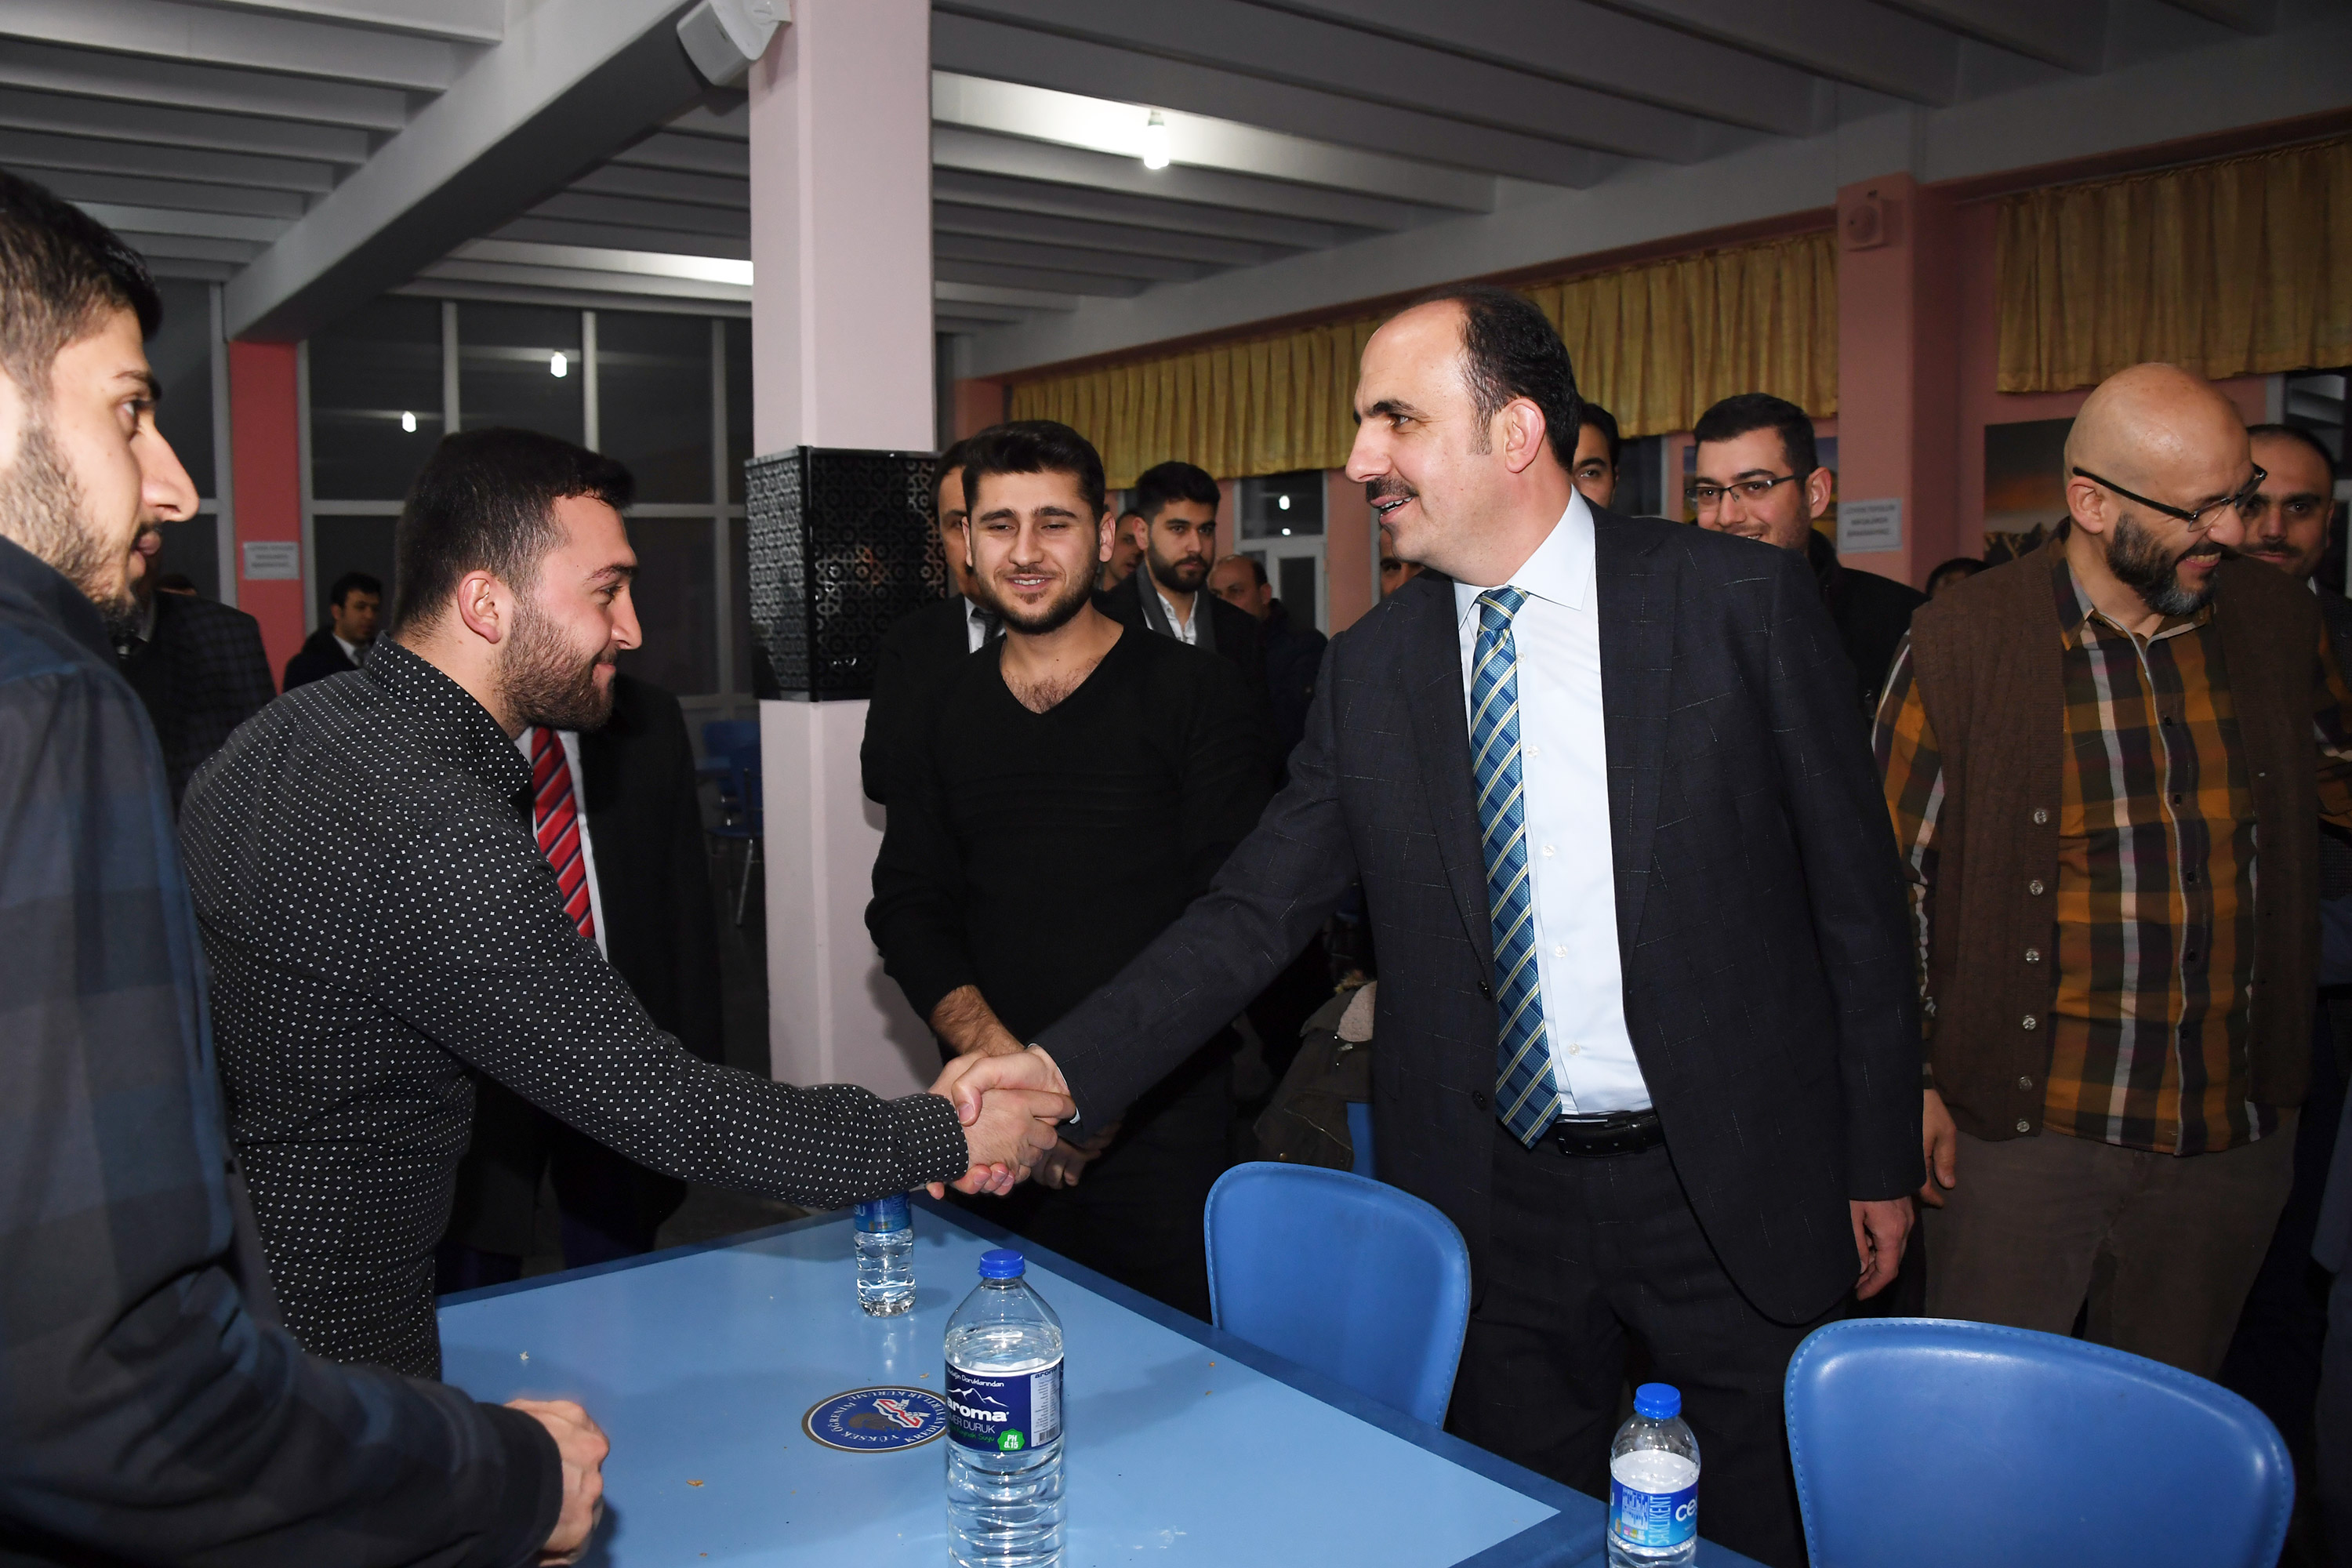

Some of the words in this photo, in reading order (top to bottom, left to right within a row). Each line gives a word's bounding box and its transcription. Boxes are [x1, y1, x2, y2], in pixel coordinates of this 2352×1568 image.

[961, 1374, 1004, 1388] Doruklarından
[947, 1396, 1007, 1422] aroma
[963, 1419, 996, 1434] DURUK
[1004, 1440, 1019, 1449] 8.15
[1675, 1498, 1697, 1522] ce
[1648, 1495, 1671, 1545] SAKLIKENT
